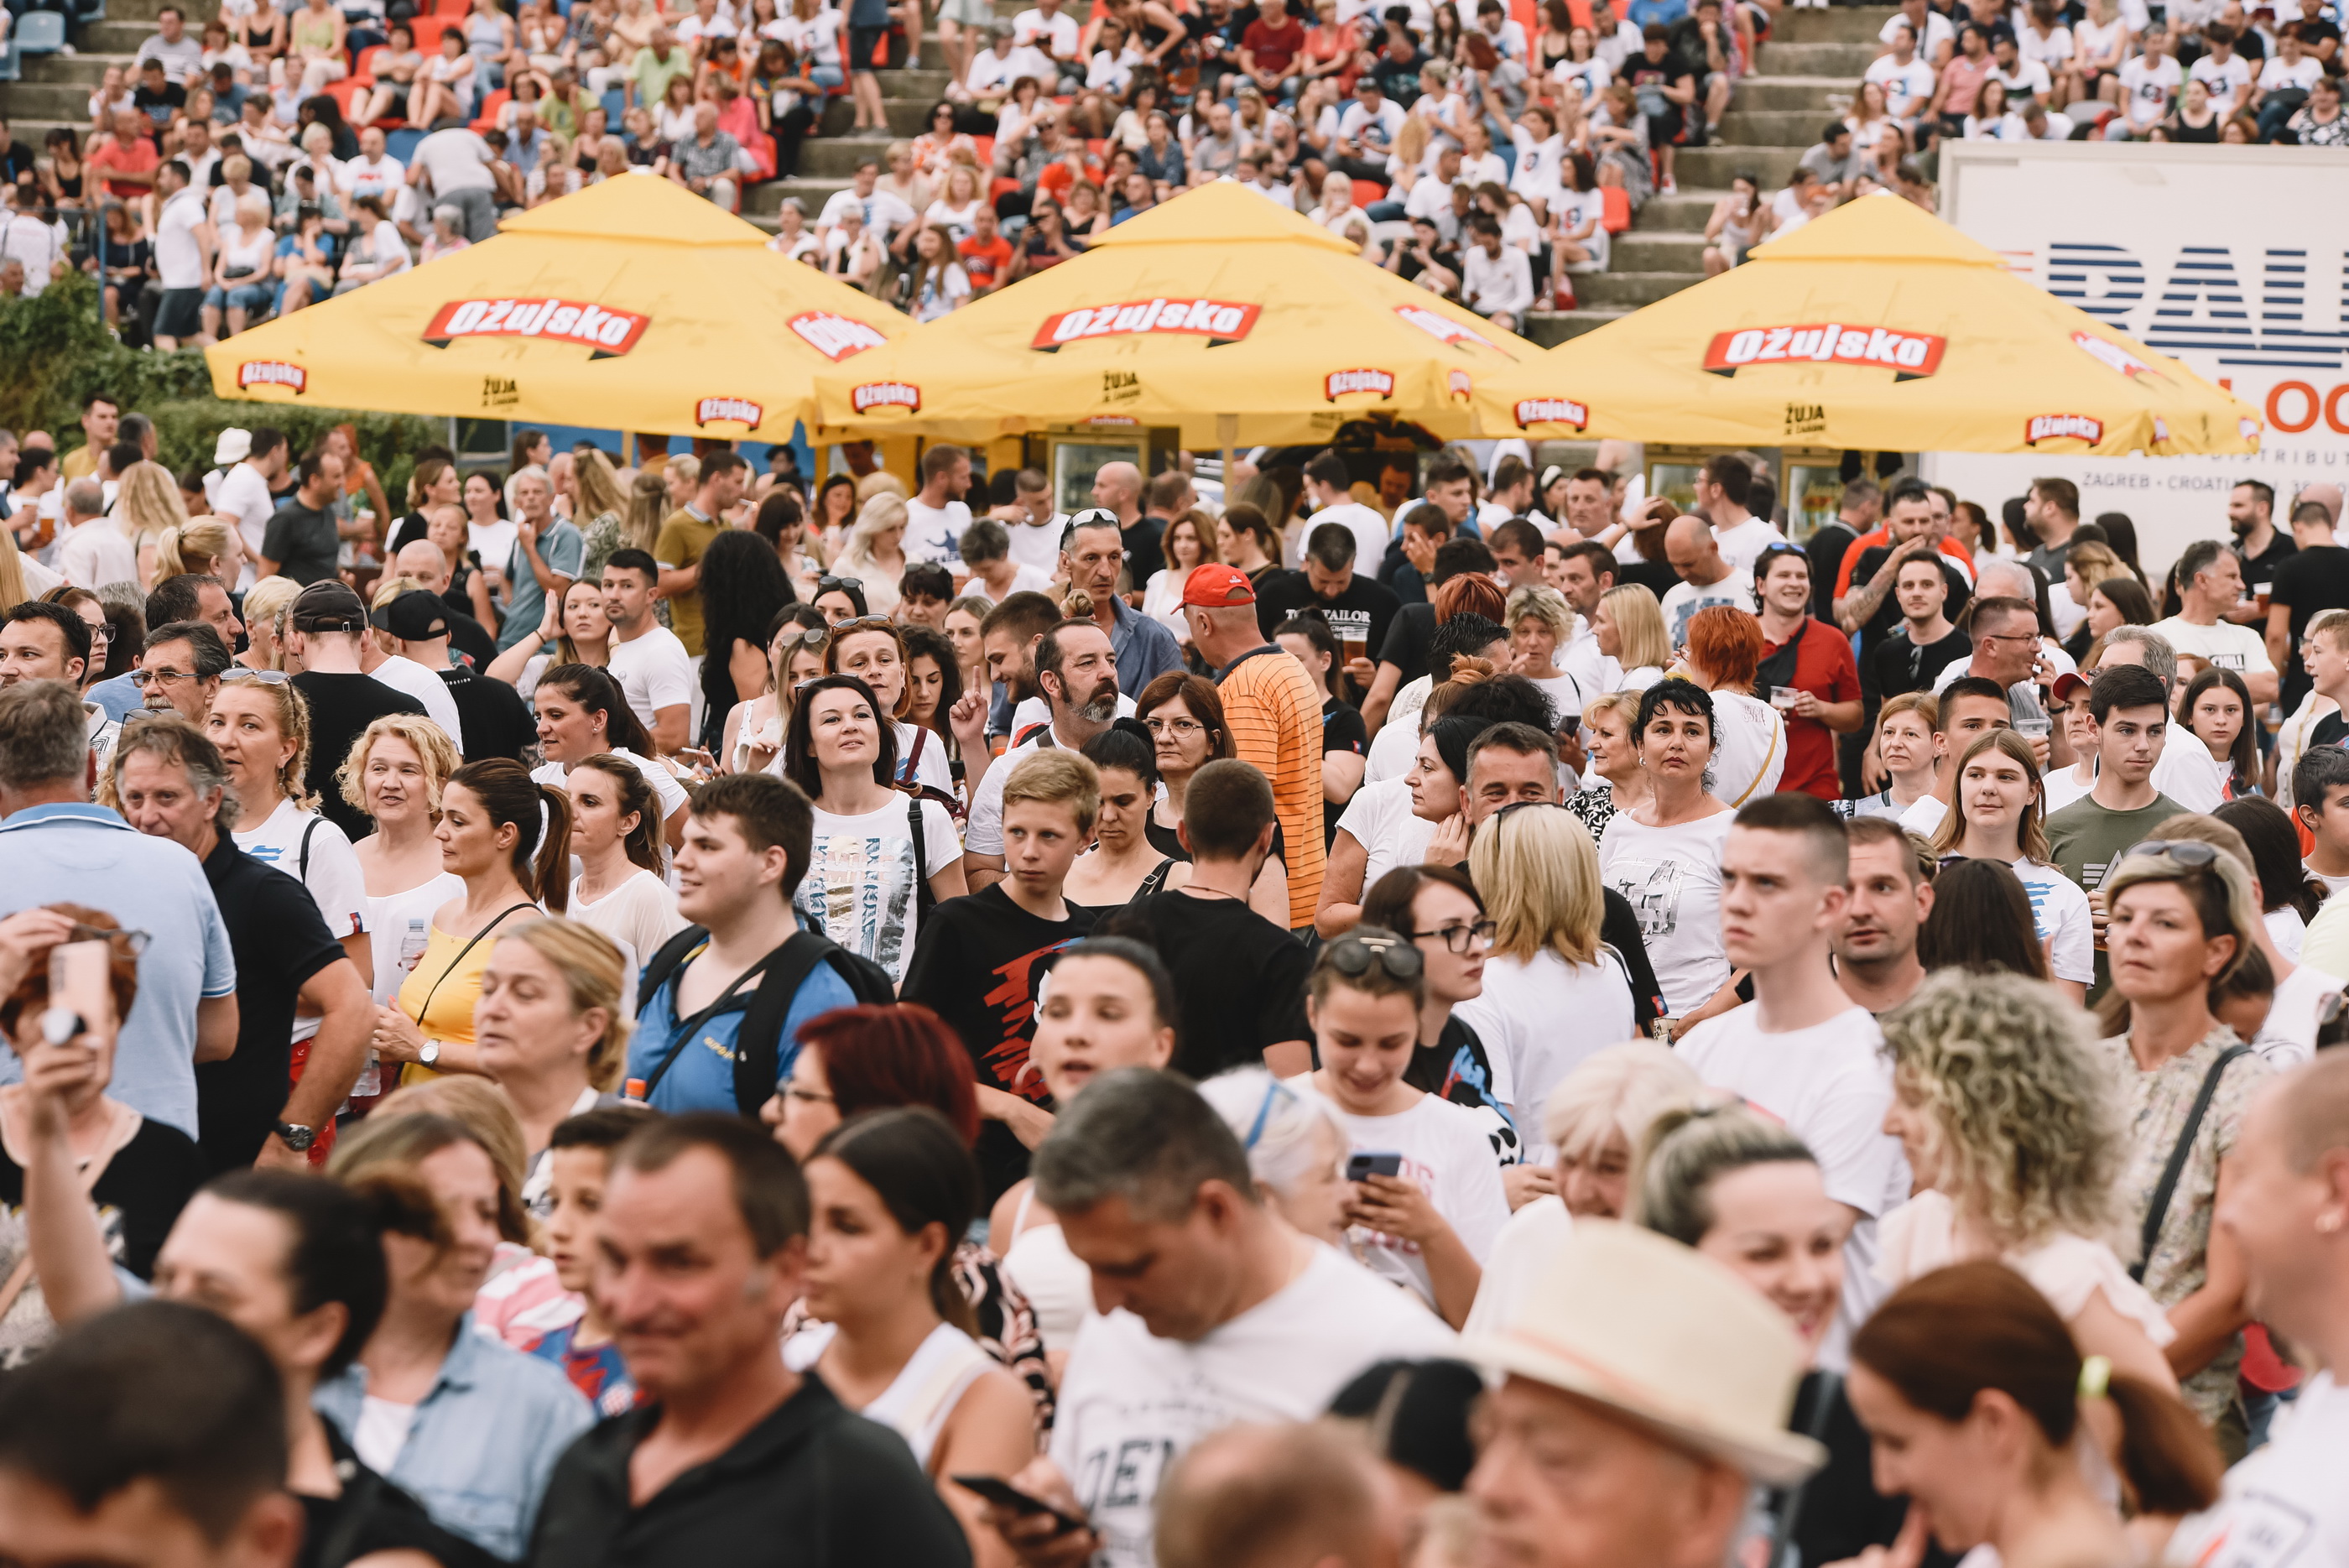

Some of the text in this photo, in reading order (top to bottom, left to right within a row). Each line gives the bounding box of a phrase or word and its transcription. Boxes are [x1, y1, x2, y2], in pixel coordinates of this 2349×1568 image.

[444, 298, 632, 346] Ožujsko
[1051, 298, 1245, 342] Ožujsko
[1724, 323, 1929, 367] Ožujsko
[1785, 403, 1825, 423] ŽUJA
[2082, 471, 2149, 487] ZAGREB
[1322, 609, 1372, 623] TAILOR
